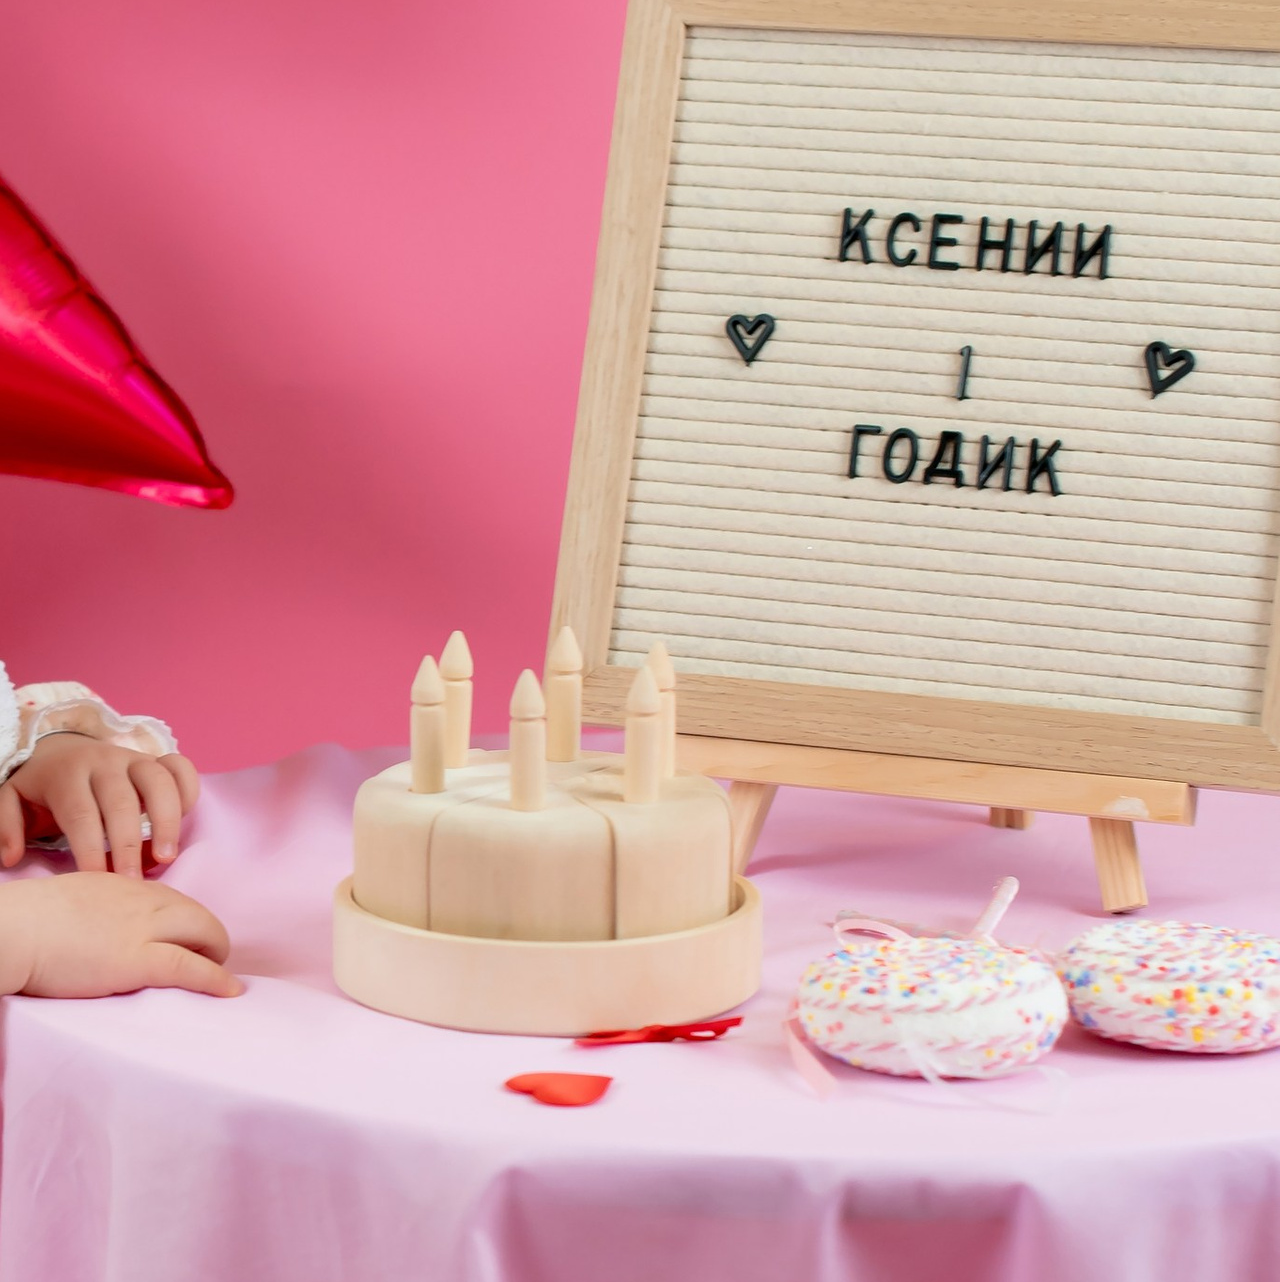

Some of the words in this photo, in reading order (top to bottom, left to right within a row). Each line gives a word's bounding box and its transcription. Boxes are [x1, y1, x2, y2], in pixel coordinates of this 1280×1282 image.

[838, 207, 1113, 280] КСЕНИИ
[956, 344, 972, 401] 1
[847, 424, 1063, 496] ГОДИК
